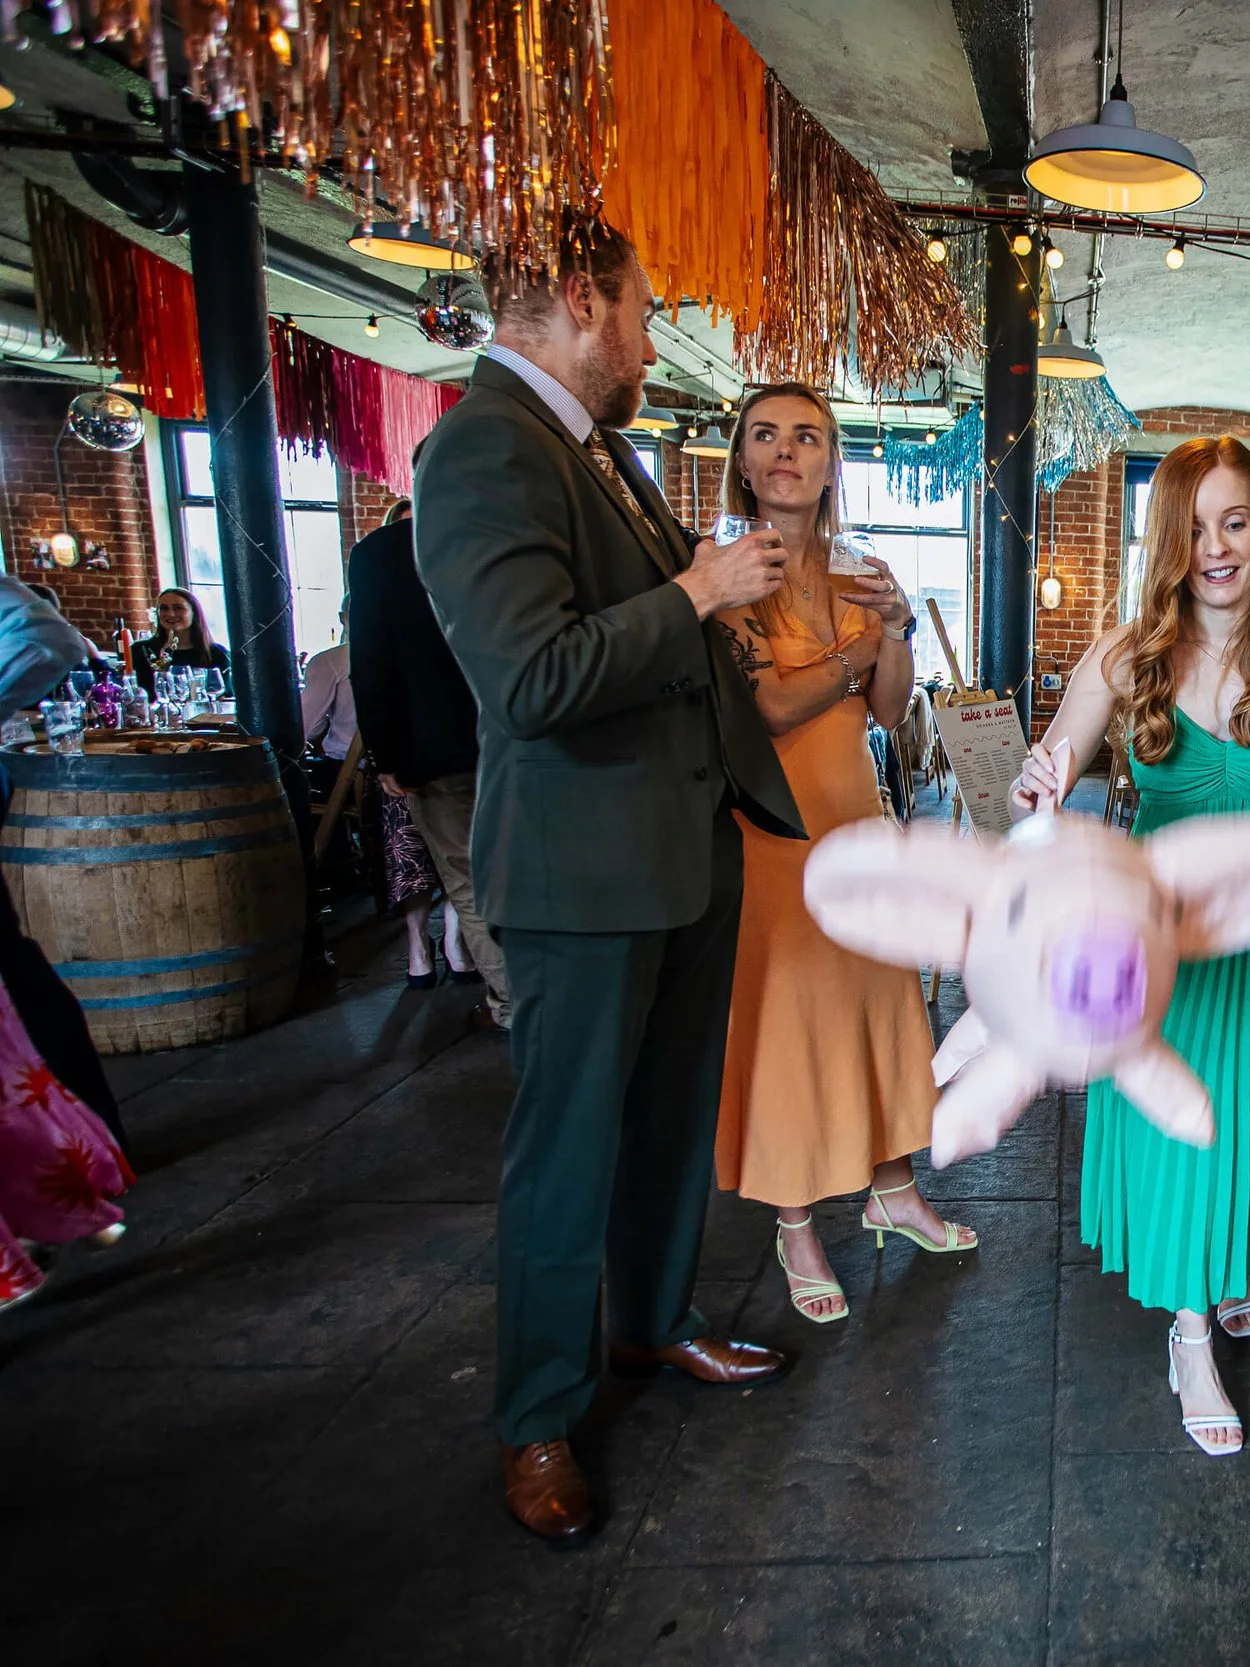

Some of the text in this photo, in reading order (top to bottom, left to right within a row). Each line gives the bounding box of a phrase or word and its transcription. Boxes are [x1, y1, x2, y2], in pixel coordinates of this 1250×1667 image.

[961, 704, 1013, 722] take a seat
